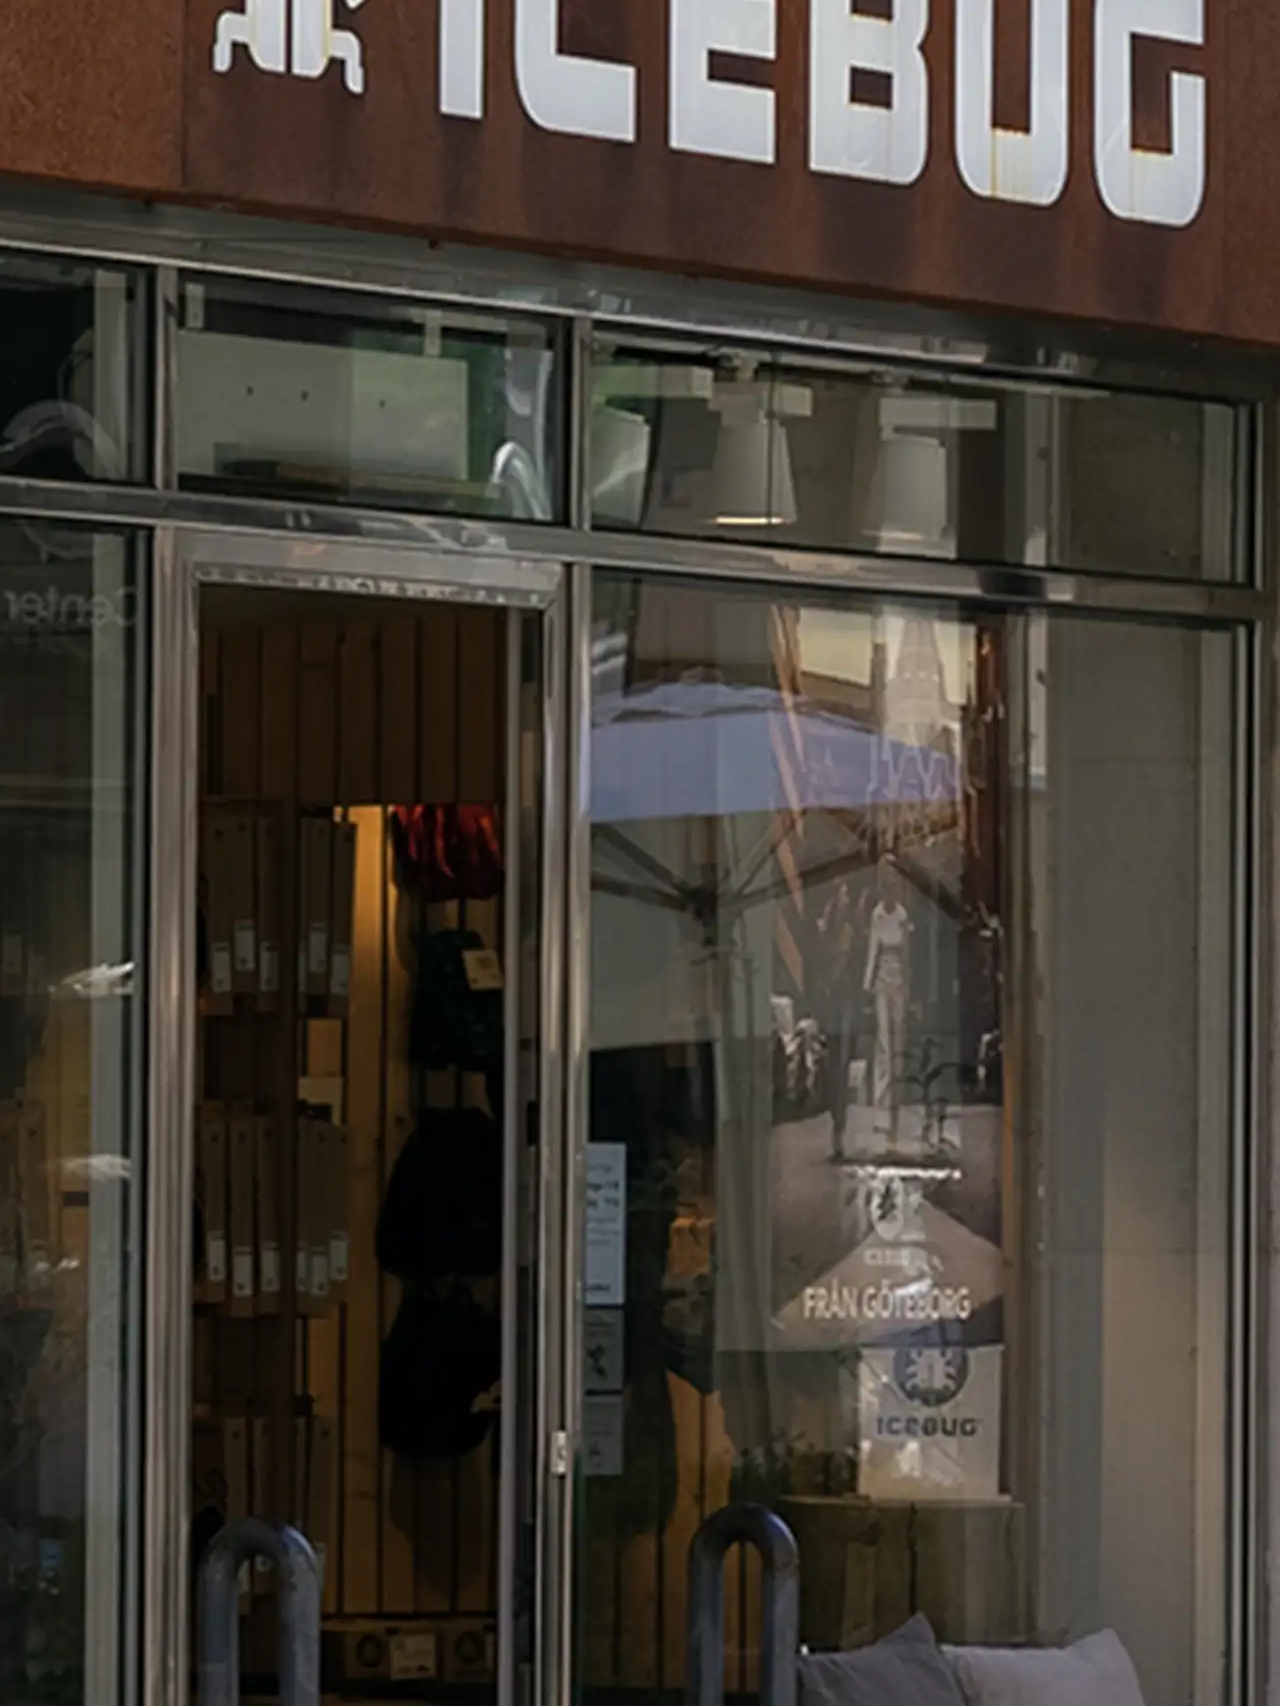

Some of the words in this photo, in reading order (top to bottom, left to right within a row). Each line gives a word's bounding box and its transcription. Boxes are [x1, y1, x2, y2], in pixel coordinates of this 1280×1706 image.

[803, 1278, 858, 1319] FRÅN
[862, 1280, 970, 1320] GÖTEBORG
[876, 1416, 977, 1437] ICEBUG
